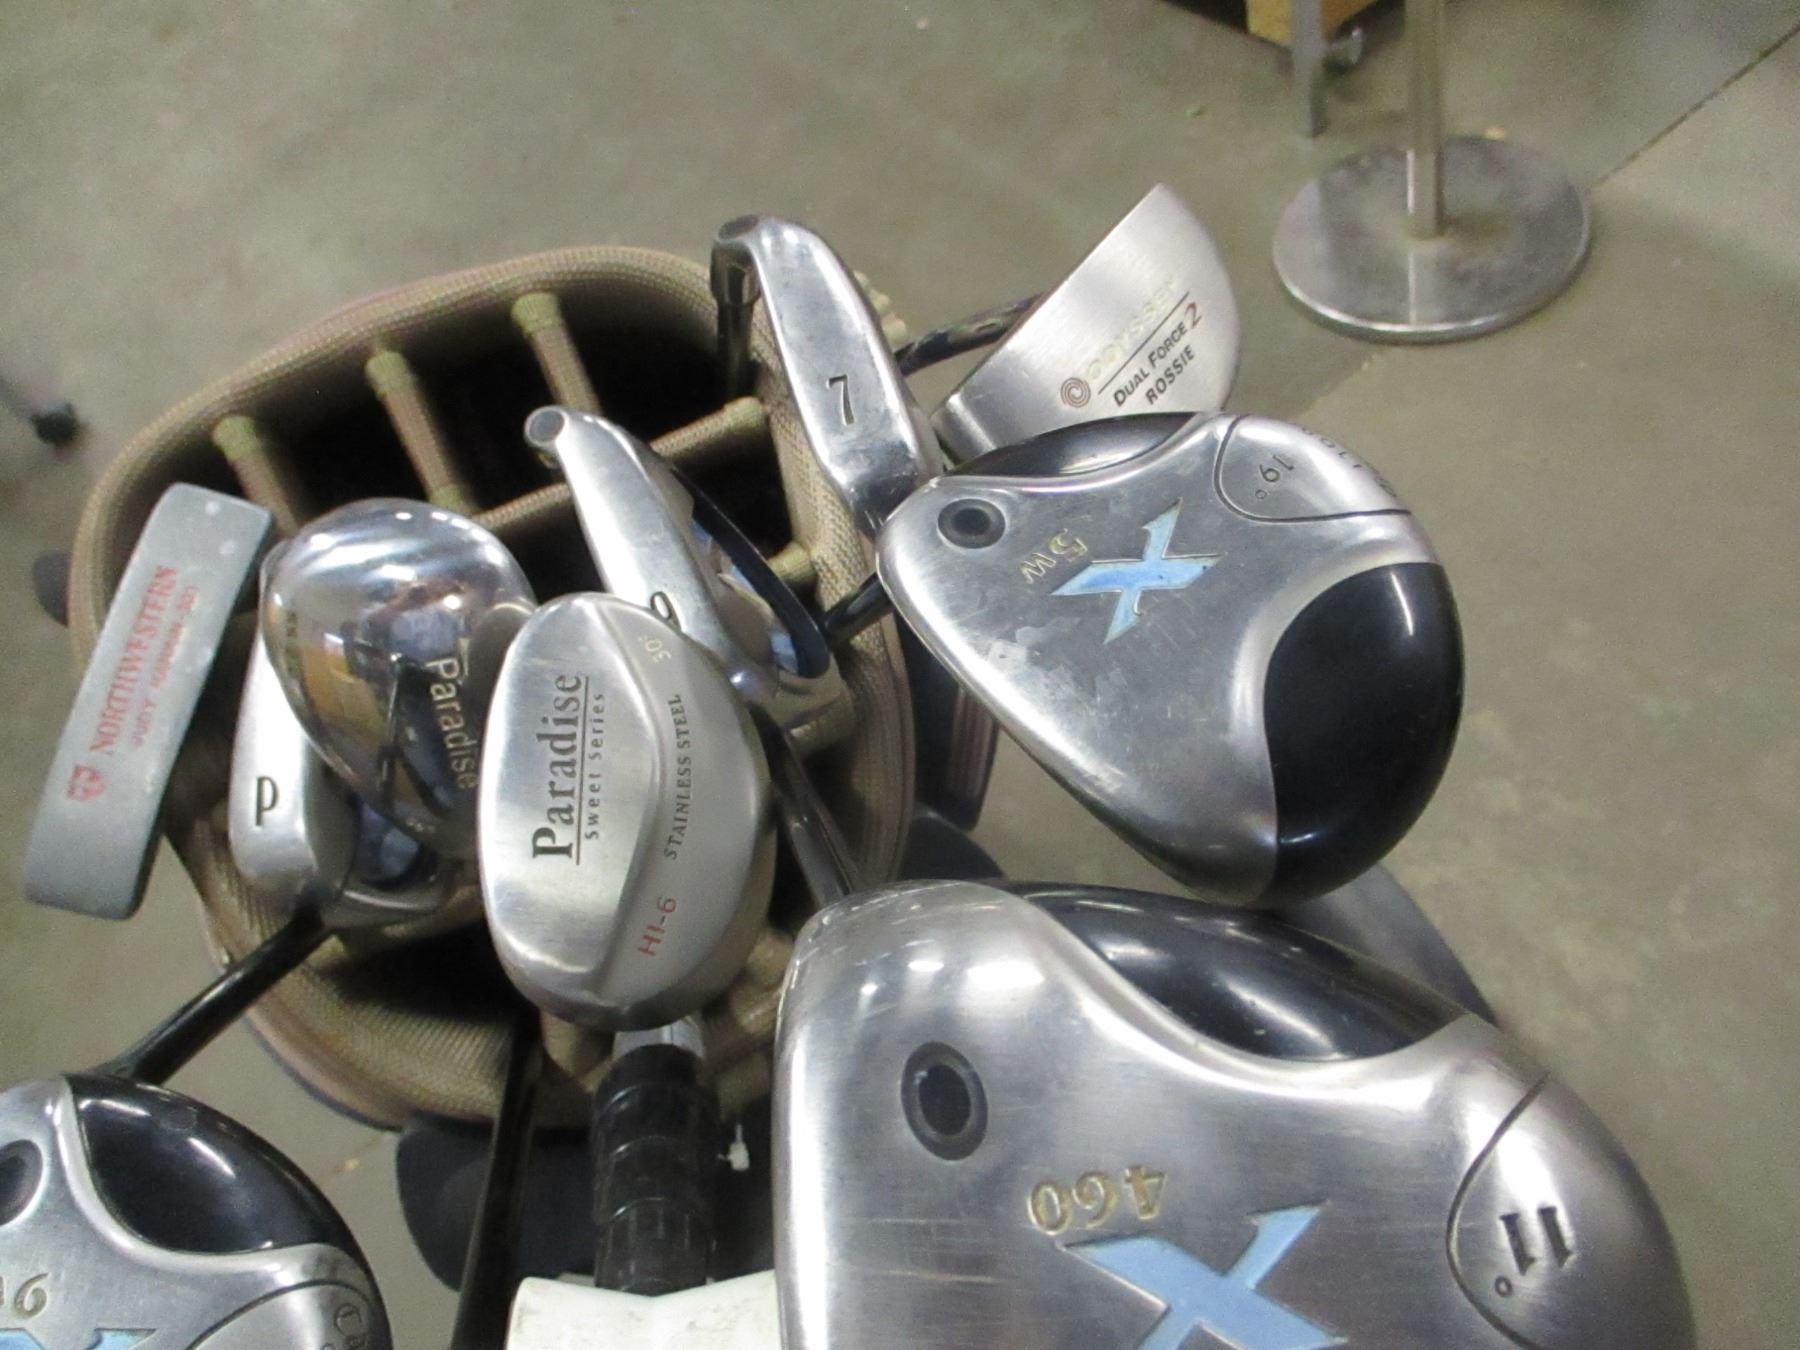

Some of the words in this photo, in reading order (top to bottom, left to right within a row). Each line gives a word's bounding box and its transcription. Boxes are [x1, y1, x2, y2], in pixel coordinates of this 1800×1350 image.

[1112, 366, 1151, 407] DUAL
[1147, 320, 1188, 369] FORCE
[1185, 301, 1203, 330] 2
[1144, 344, 1196, 406] ROSSIE
[826, 374, 855, 426] 7
[89, 565, 179, 756] NORTHWESTERN
[427, 656, 479, 790] Paradise
[590, 692, 606, 761] Series
[667, 693, 692, 752] STEEL
[254, 775, 279, 827] P
[531, 673, 583, 860] Paradise
[585, 770, 602, 841] Sweet
[663, 755, 692, 861] STAINLESS
[636, 897, 678, 957] HI-6
[1026, 1162, 1167, 1236] 460
